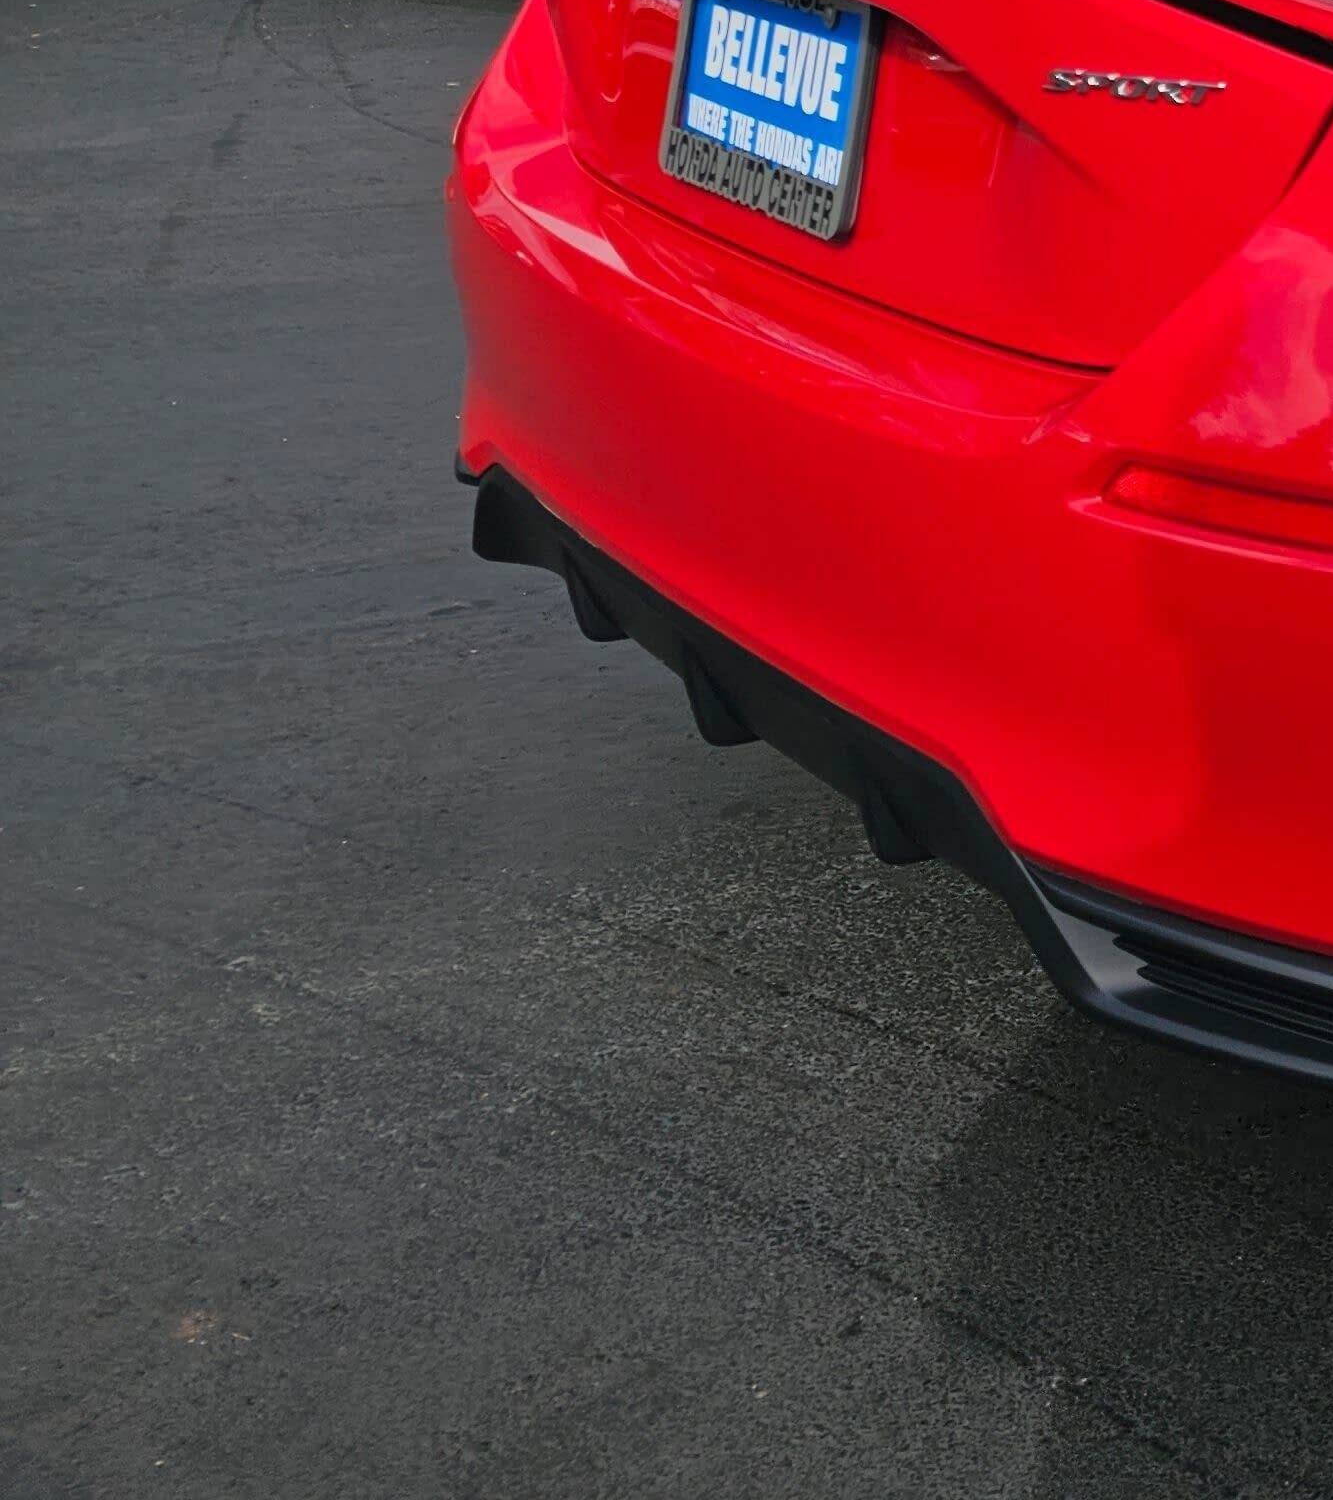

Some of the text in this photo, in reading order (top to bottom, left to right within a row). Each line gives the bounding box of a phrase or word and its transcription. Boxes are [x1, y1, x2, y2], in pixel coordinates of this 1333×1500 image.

[704, 5, 847, 121] BELLEVUE
[1041, 68, 1227, 106] SPORT
[687, 93, 730, 142] WHERE
[728, 110, 756, 151] THE
[755, 120, 813, 176] HONDAS
[665, 130, 834, 237] HONDA AUTO CENTER
